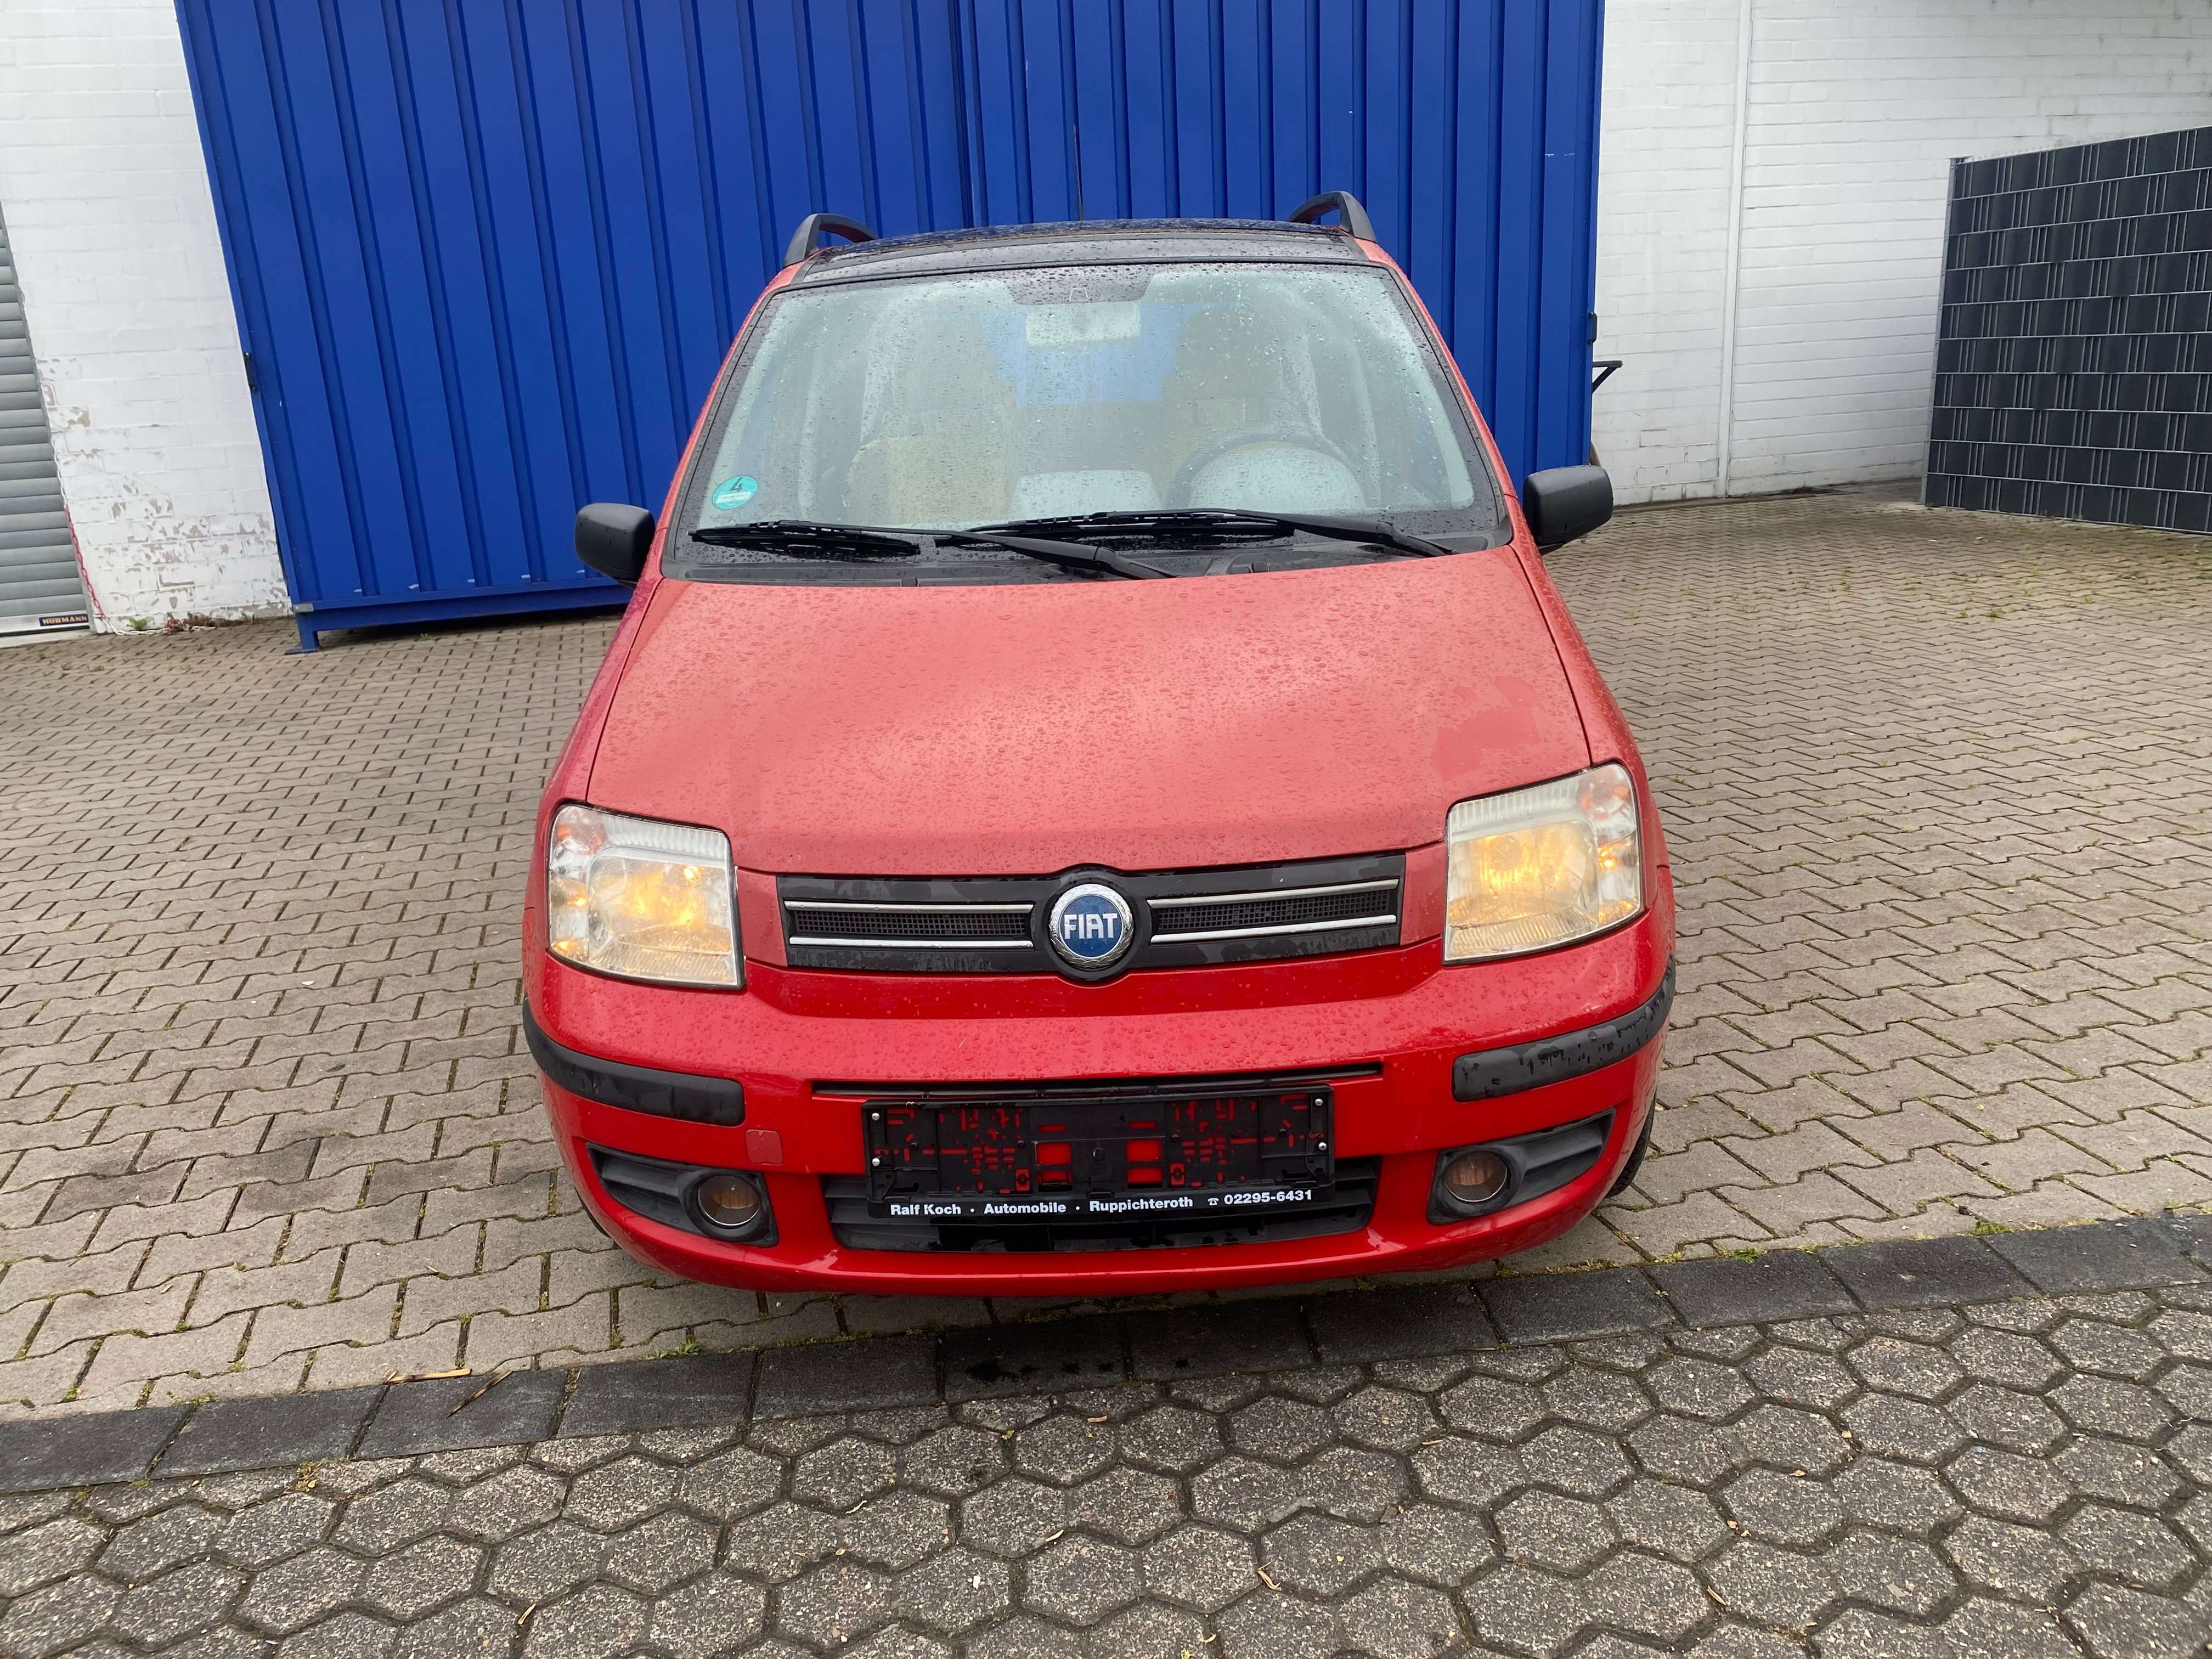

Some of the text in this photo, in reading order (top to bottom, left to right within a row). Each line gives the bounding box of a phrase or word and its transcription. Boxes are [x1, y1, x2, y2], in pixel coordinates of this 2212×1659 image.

[729, 477, 742, 492] 4
[1064, 913, 1118, 940] FIAT
[890, 1189, 1311, 1215] Ralf Koch Automobile Ruppichteroth 02295-6431
